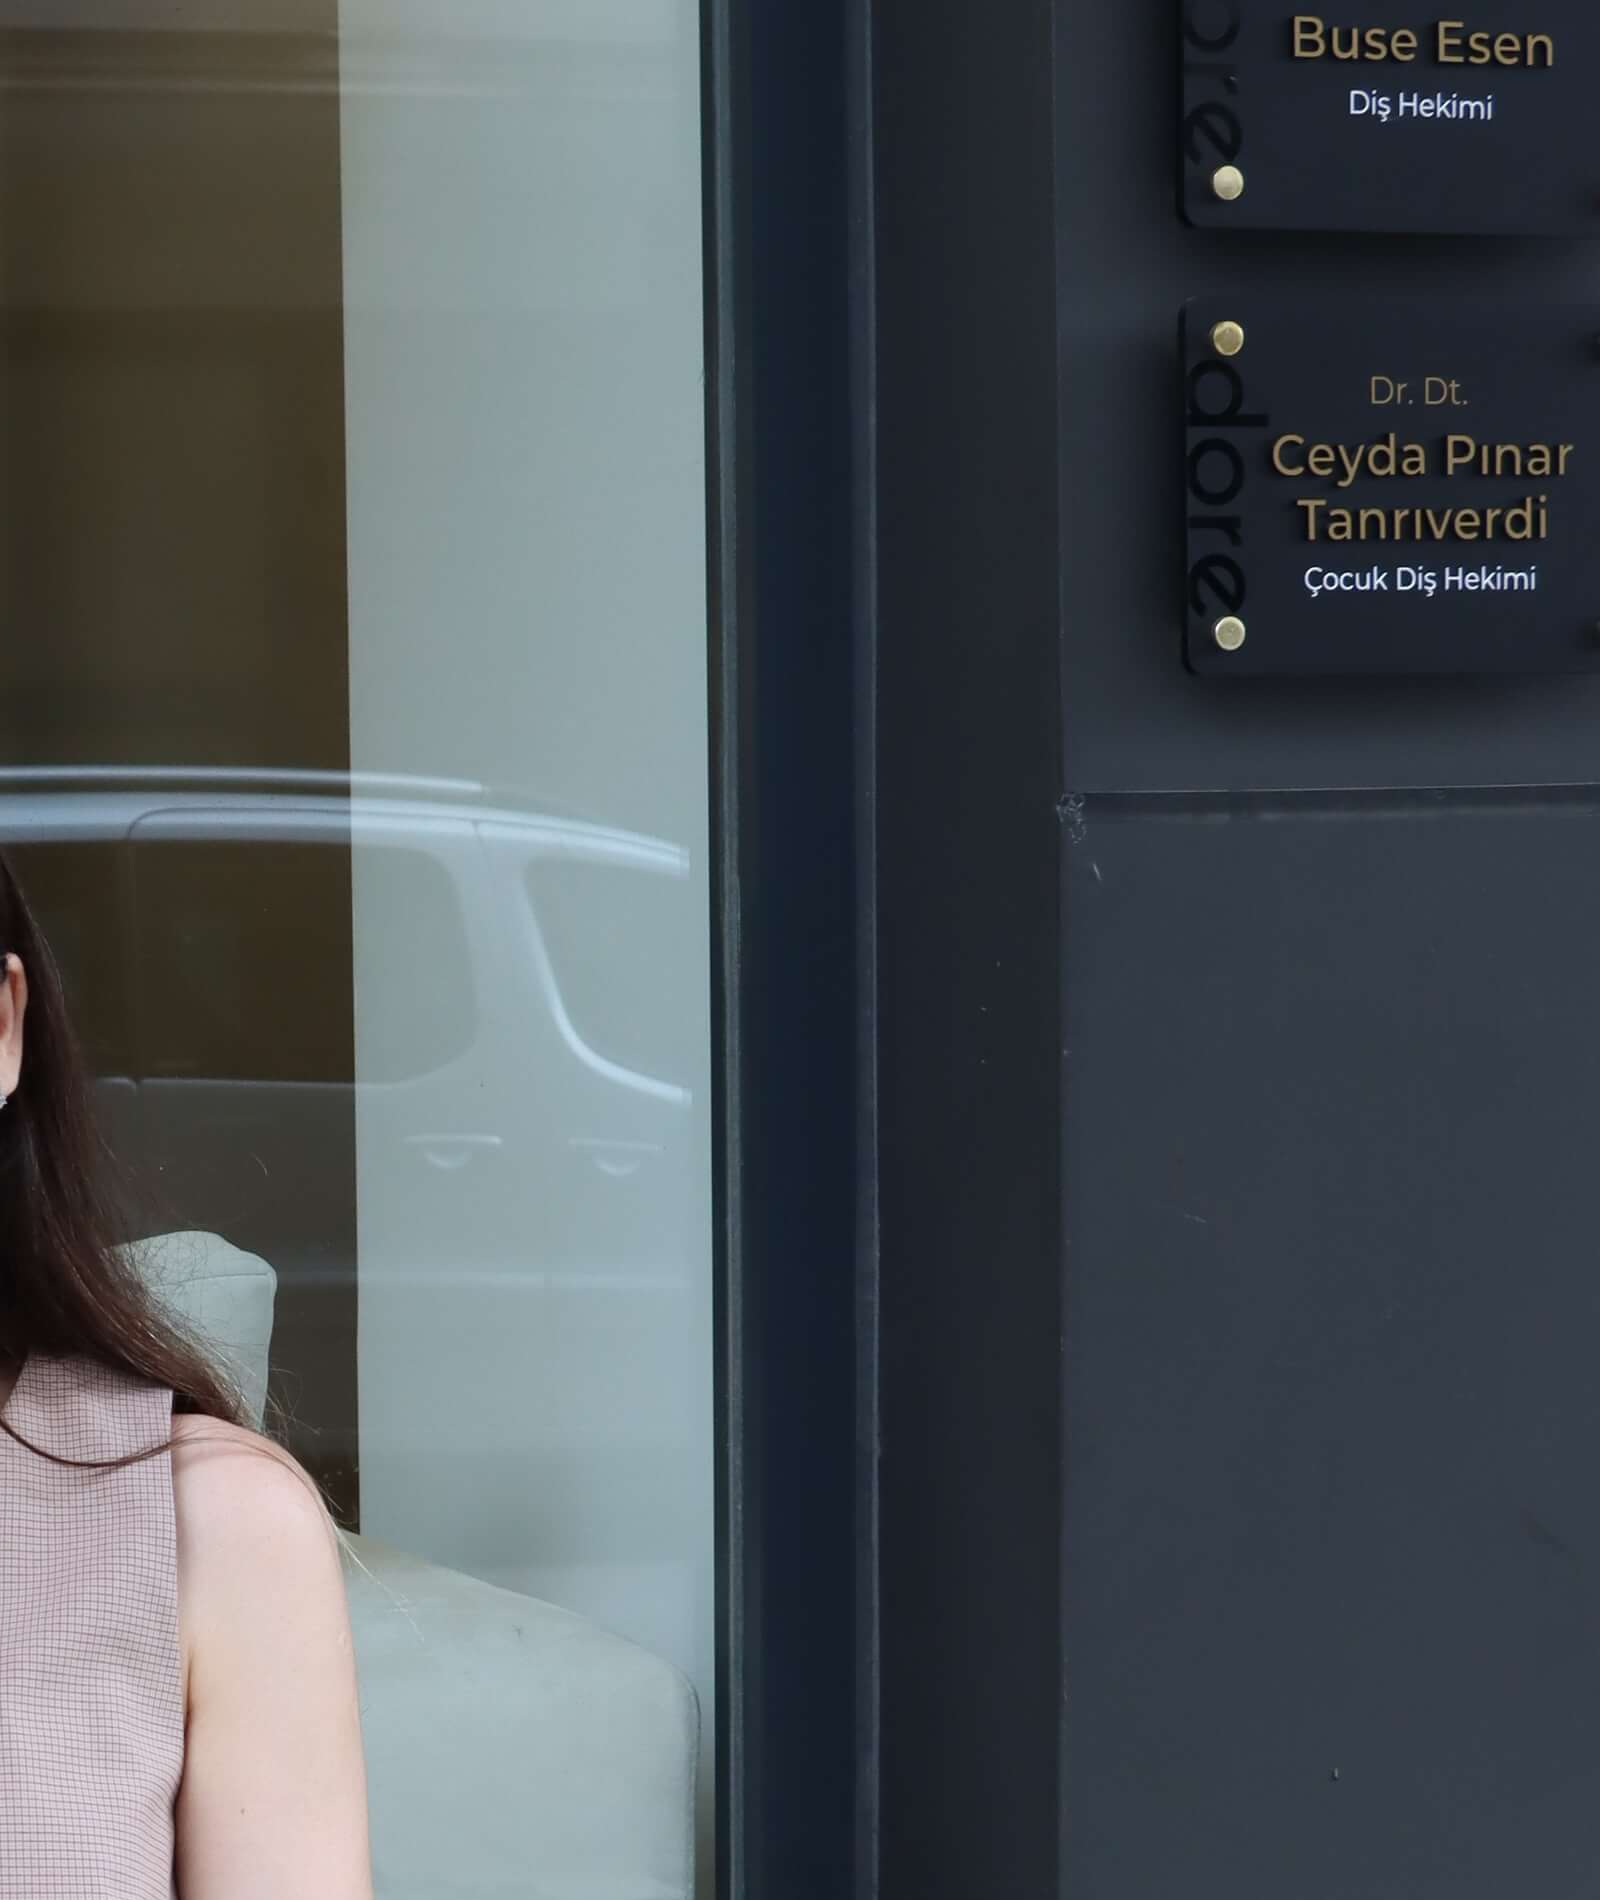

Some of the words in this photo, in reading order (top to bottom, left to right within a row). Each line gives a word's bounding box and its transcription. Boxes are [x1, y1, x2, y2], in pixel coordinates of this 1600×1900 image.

[1293, 15, 1418, 62] Buse
[1437, 20, 1554, 67] Esen
[1184, 0, 1243, 165] ore
[1349, 89, 1391, 122] Diş
[1398, 91, 1494, 120] Hekimi
[1370, 375, 1414, 405] Dr.
[1424, 376, 1469, 406] Dt.
[1271, 432, 1426, 488] Ceyda
[1446, 434, 1575, 477] Pınar
[1186, 358, 1268, 617] dore
[1296, 494, 1548, 541] Tanrıverdi
[1303, 565, 1389, 597] Çocuk
[1395, 565, 1438, 597] Diş
[1443, 565, 1537, 591] Hekimi
